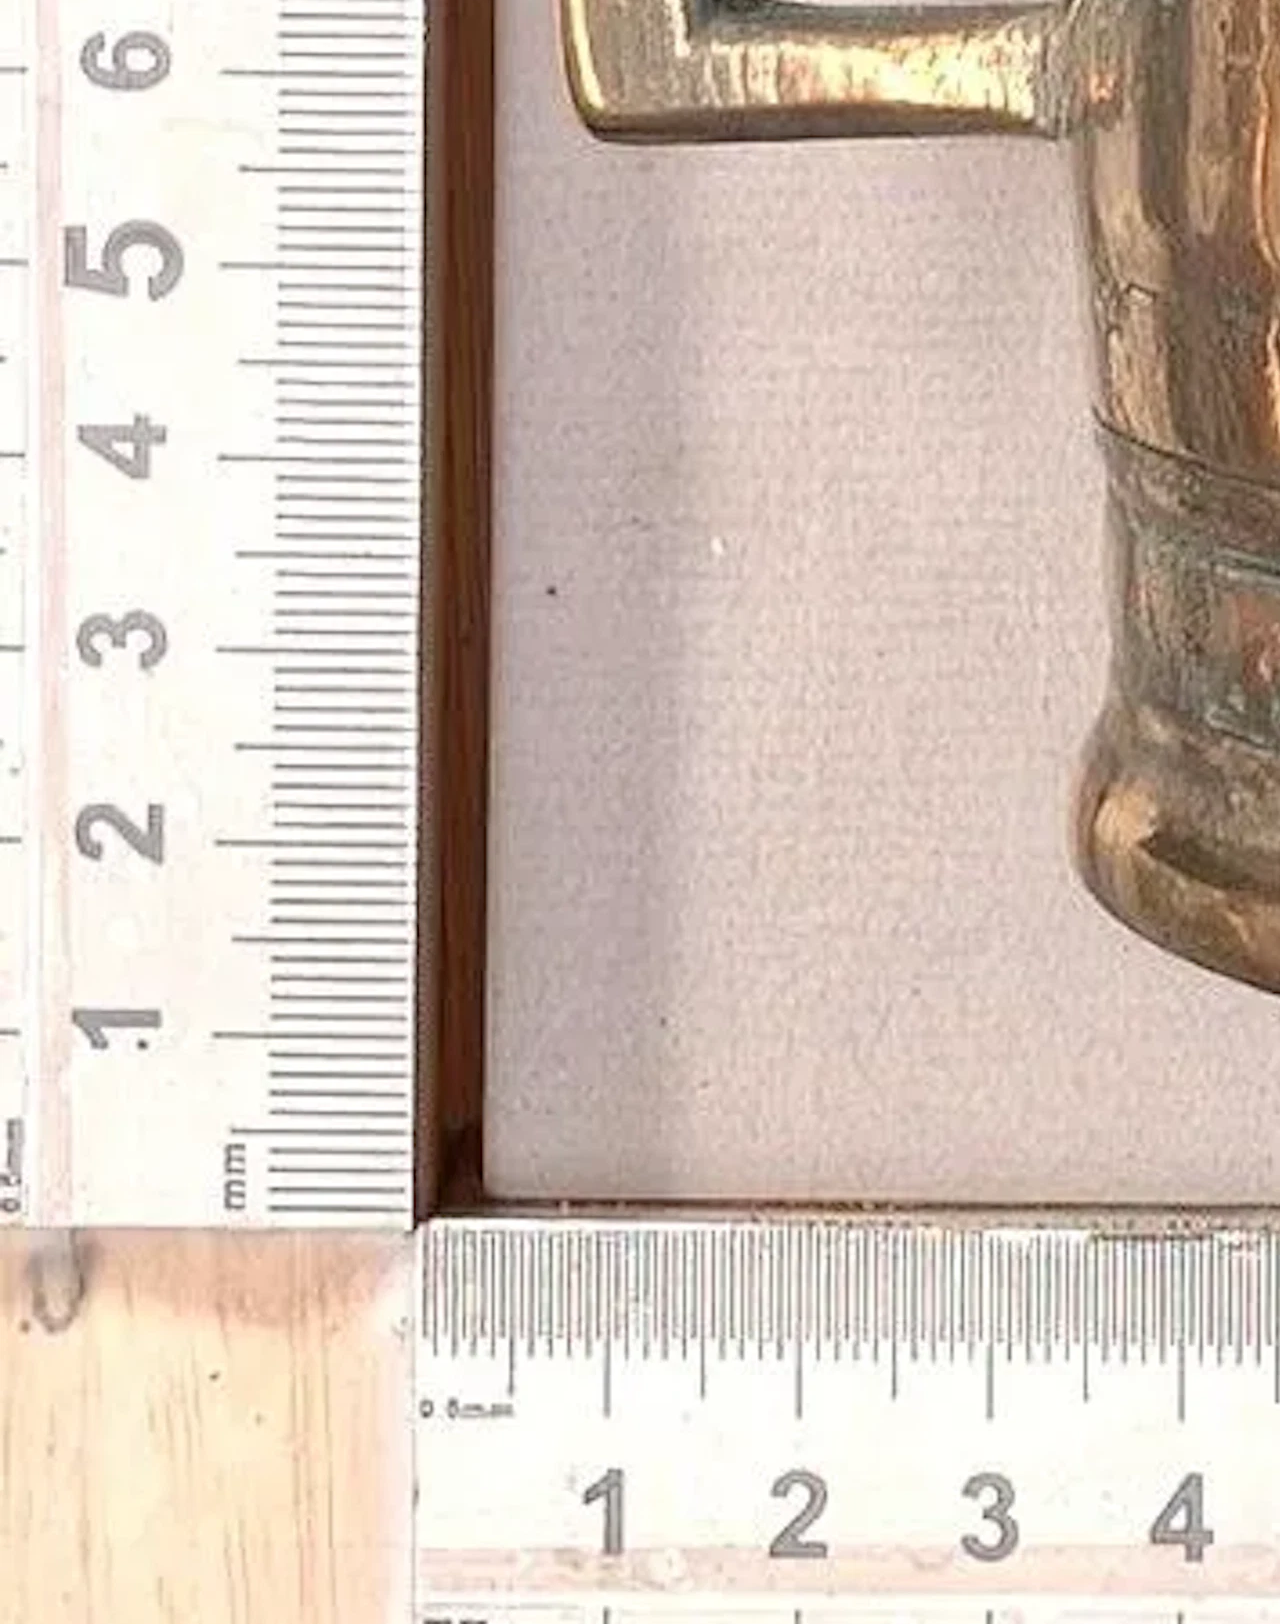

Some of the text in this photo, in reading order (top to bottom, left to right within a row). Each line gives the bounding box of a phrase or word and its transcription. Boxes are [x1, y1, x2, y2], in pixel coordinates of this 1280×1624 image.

[79, 31, 172, 92] 6
[63, 220, 184, 302] 5
[77, 413, 167, 480] 4
[76, 609, 168, 673] 3
[74, 803, 165, 866] 2
[70, 1007, 163, 1051] 1
[222, 1142, 247, 1212] mm
[582, 1467, 626, 1557] 1
[767, 1467, 830, 1560] 2
[960, 1472, 1020, 1563] 3
[1148, 1472, 1216, 1564] 4
